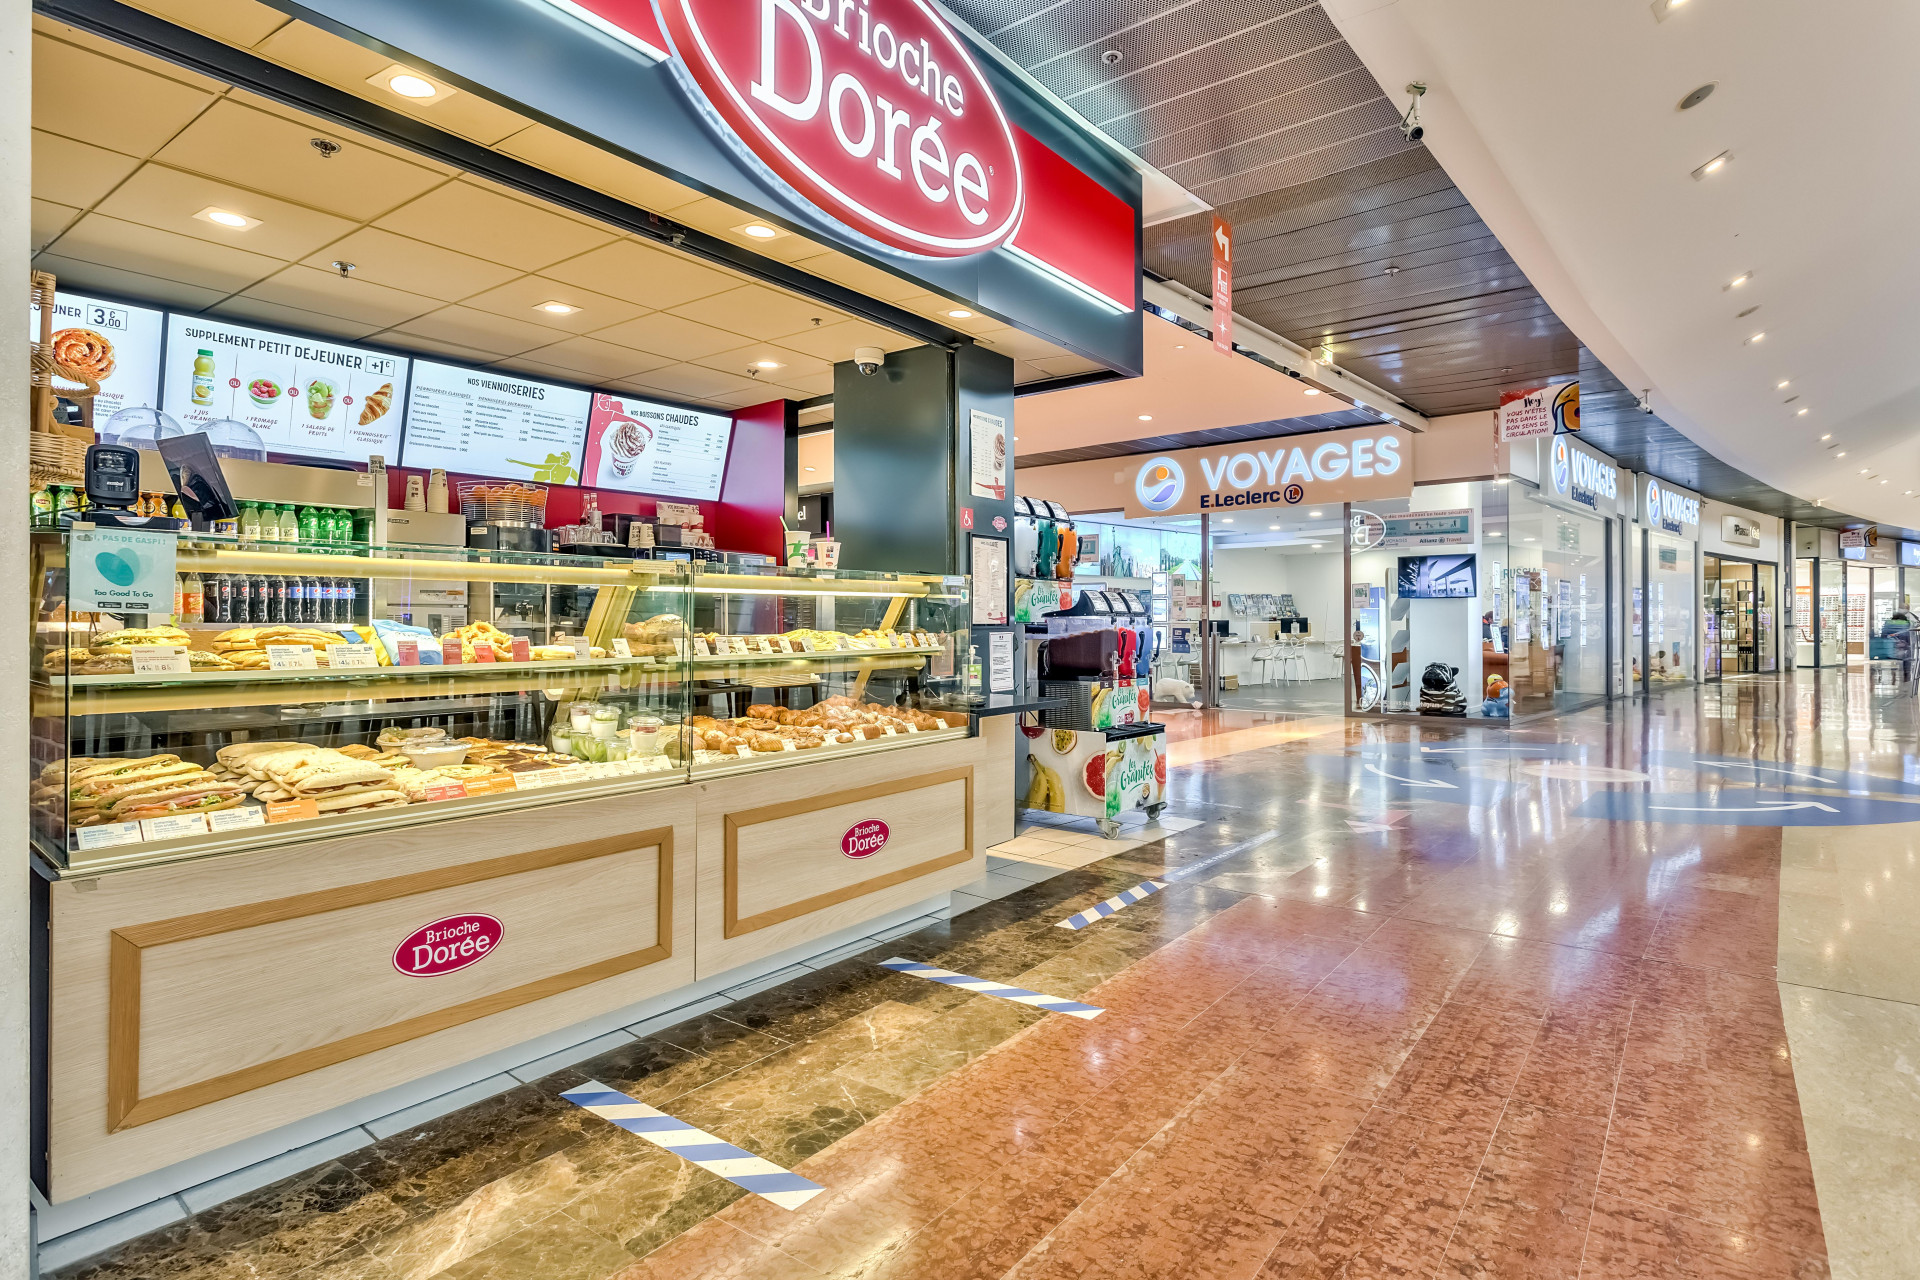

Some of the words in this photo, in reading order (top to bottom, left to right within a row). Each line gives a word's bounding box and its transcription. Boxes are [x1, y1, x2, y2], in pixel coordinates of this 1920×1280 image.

[750, 0, 990, 226] Dorée
[258, 340, 291, 356] PETIT
[231, 379, 240, 387] OU
[467, 378, 480, 387] NOS
[481, 379, 546, 401] VIENNOISERIES
[289, 388, 298, 396] OU
[1523, 392, 1544, 408] Hey!
[250, 416, 278, 425] FROMAGE
[666, 413, 699, 426] CHAUDES
[1520, 415, 1537, 423] DANS
[1506, 427, 1549, 438] CIRCULATION!
[357, 437, 383, 445] CLASSIQUE
[1200, 436, 1400, 491] VOYAGES
[1571, 448, 1617, 500] VOYAGES
[1200, 489, 1281, 508] E.Leclerc
[1662, 489, 1700, 526] VOYAGES
[102, 534, 119, 542] PAS
[110, 589, 130, 597] Good
[1121, 760, 1154, 790] Granités
[854, 821, 880, 838] Brioche
[849, 832, 886, 853] Dorée
[425, 921, 480, 945] Brioche
[413, 933, 491, 970] Dorée
